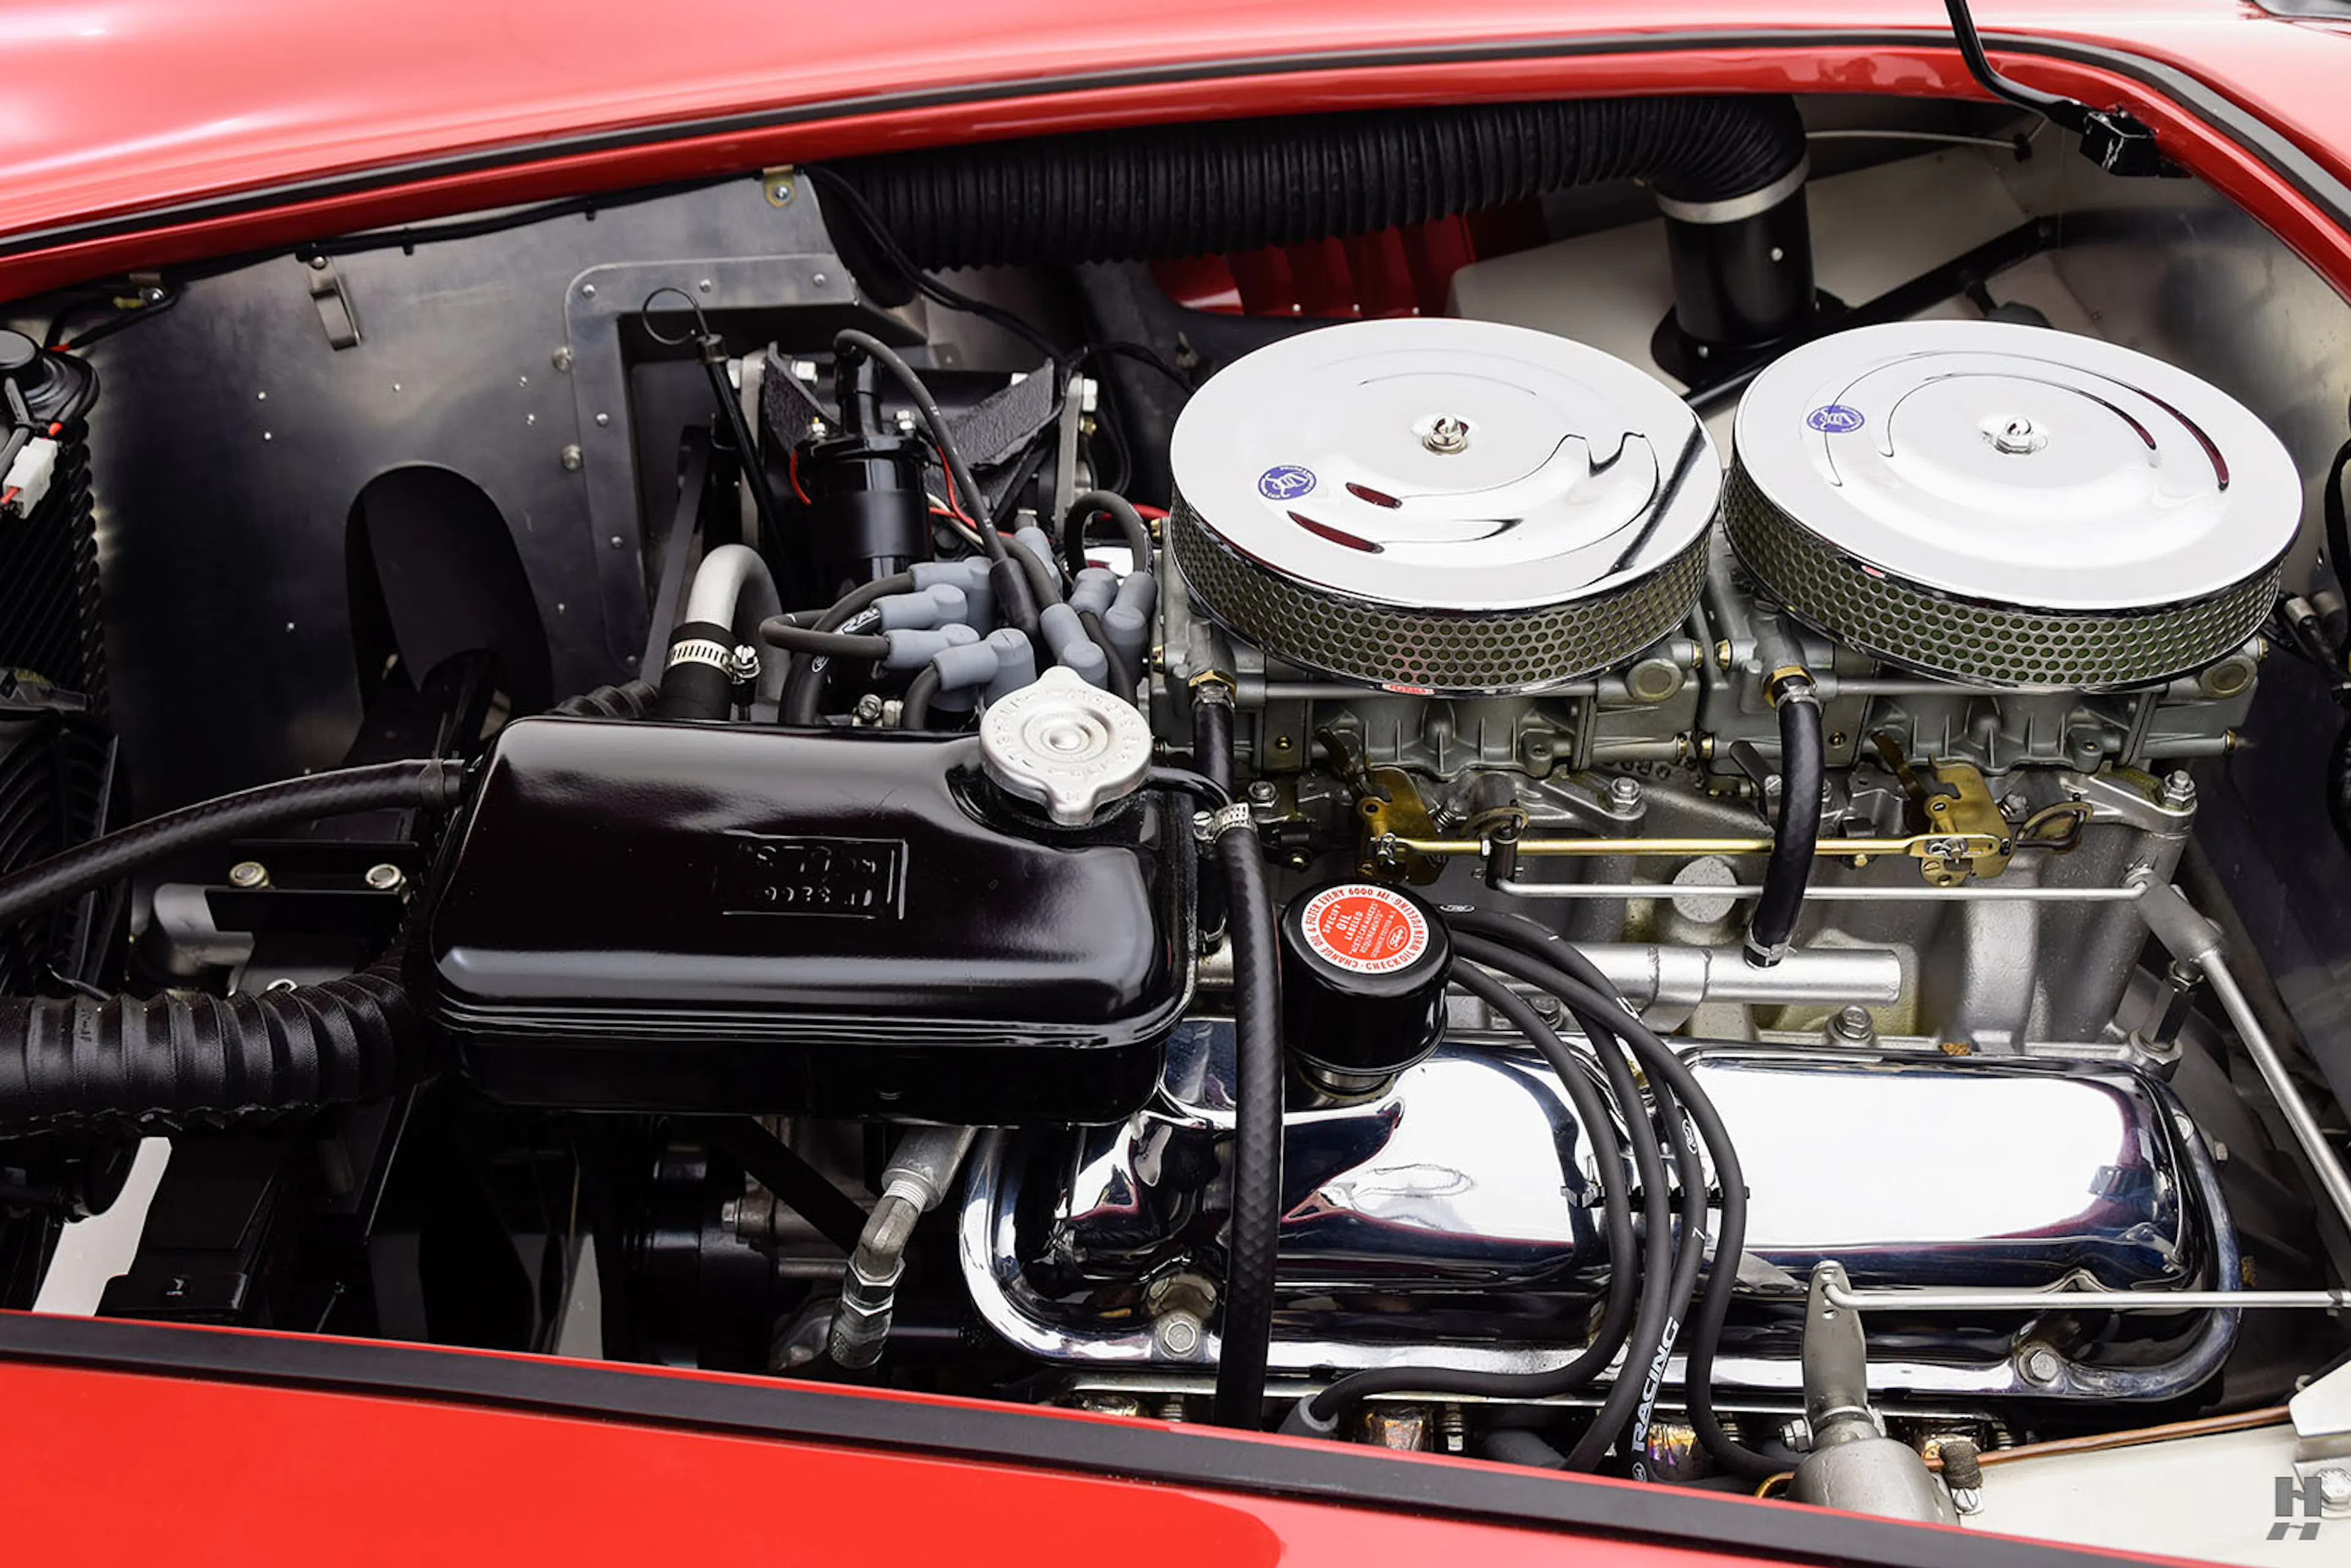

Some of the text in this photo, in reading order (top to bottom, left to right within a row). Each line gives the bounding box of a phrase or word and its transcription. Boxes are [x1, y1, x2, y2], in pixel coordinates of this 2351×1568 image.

[1318, 888, 1344, 905] EVERY
[1348, 887, 1373, 896] 6000
[1305, 904, 1322, 926] FILTER
[1321, 903, 1341, 934] SPECIFY
[1335, 914, 1352, 931] OIL
[1393, 898, 1423, 928] FUELING
[1343, 910, 1363, 941] LABELED
[1310, 934, 1324, 947] OIL
[1320, 947, 1359, 968] CHANGE
[1365, 958, 1402, 970] CHECK
[1398, 950, 1415, 962] OIL
[1631, 1316, 1680, 1452] RACING
